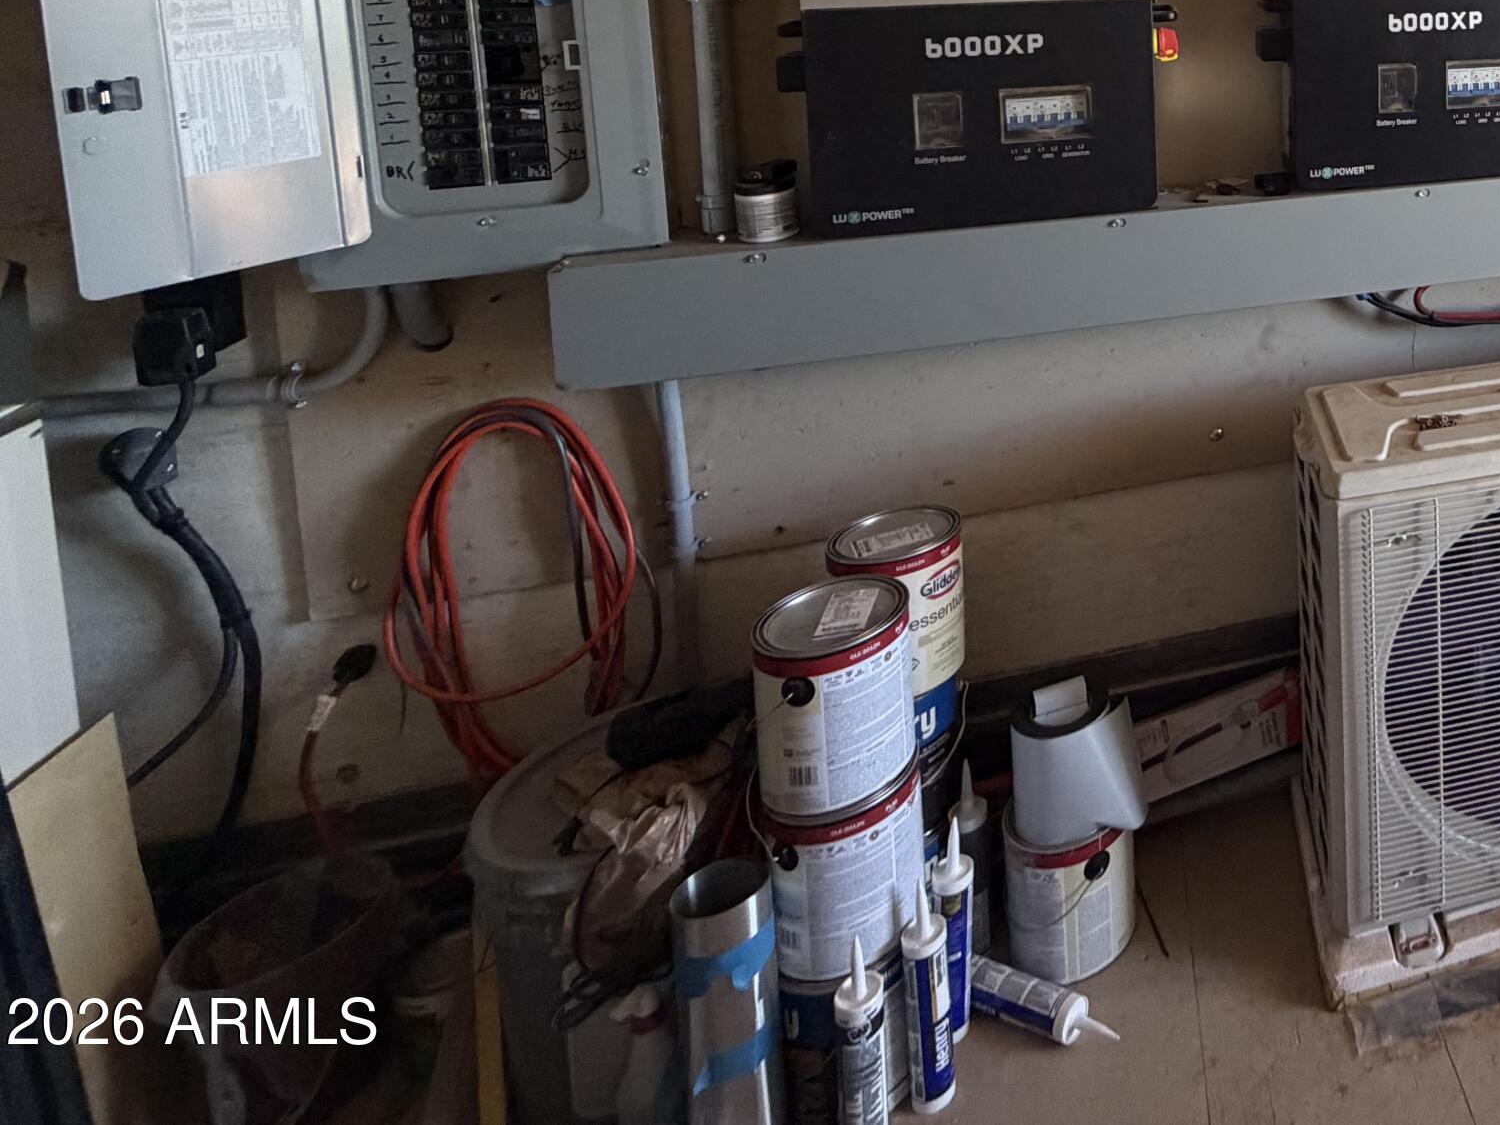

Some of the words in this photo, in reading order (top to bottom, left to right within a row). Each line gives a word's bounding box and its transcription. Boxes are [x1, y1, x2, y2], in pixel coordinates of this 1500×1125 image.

[1388, 10, 1483, 32] 6000XP
[924, 33, 1044, 59] 6000XP
[914, 156, 939, 165] Battery
[940, 154, 967, 163] Breaker
[935, 1017, 950, 1073] Henry
